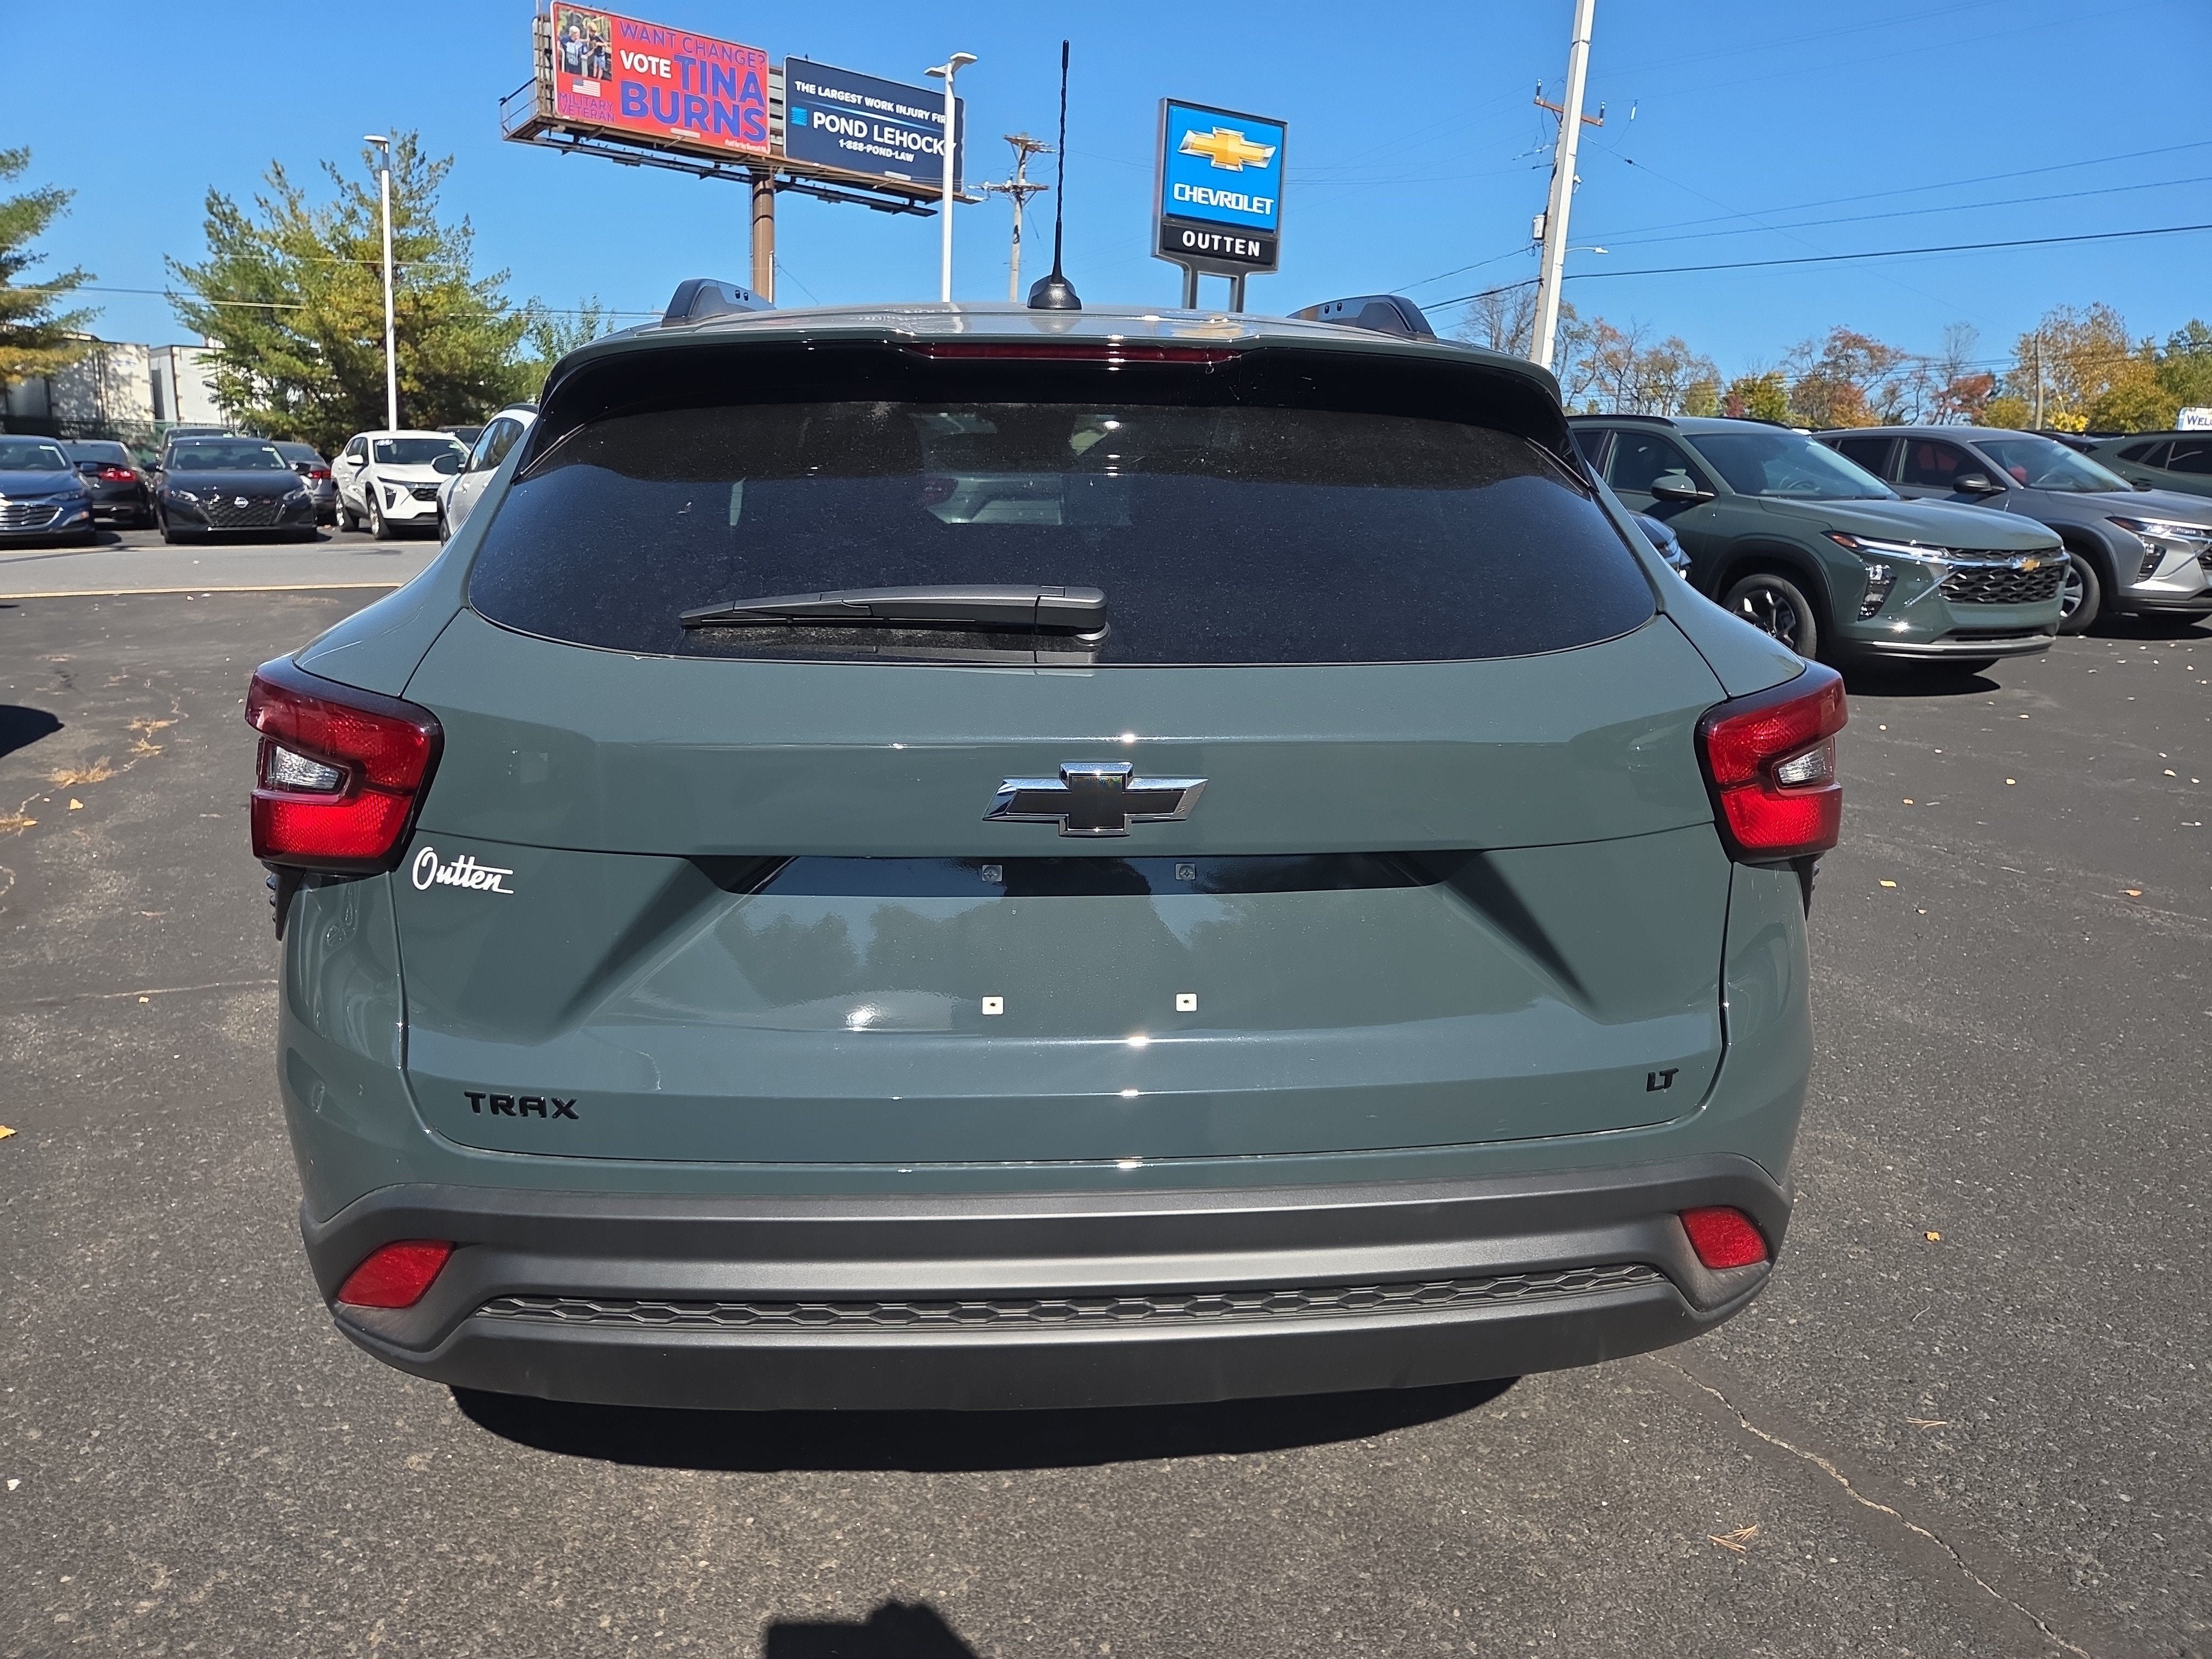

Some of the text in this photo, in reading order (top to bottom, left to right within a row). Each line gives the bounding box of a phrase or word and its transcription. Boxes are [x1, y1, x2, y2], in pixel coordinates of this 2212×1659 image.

[619, 20, 766, 70] WANT CHANGE?
[620, 49, 672, 79] VOTE
[673, 53, 765, 107] TINA
[559, 92, 614, 112] MILITARY
[561, 102, 616, 123] VETERAN
[620, 80, 767, 143] BURNS
[794, 81, 946, 124] THE LARGEST WORK INJURY FIR
[813, 112, 957, 156] POND LEHOCK
[839, 138, 915, 163] 1-888-POND-LAW
[1173, 183, 1274, 215] CHEVROLET
[1182, 230, 1261, 257] OUTTEN
[413, 846, 514, 894] Outten
[1647, 1068, 1679, 1092] LT
[464, 1090, 580, 1120] TRAX
